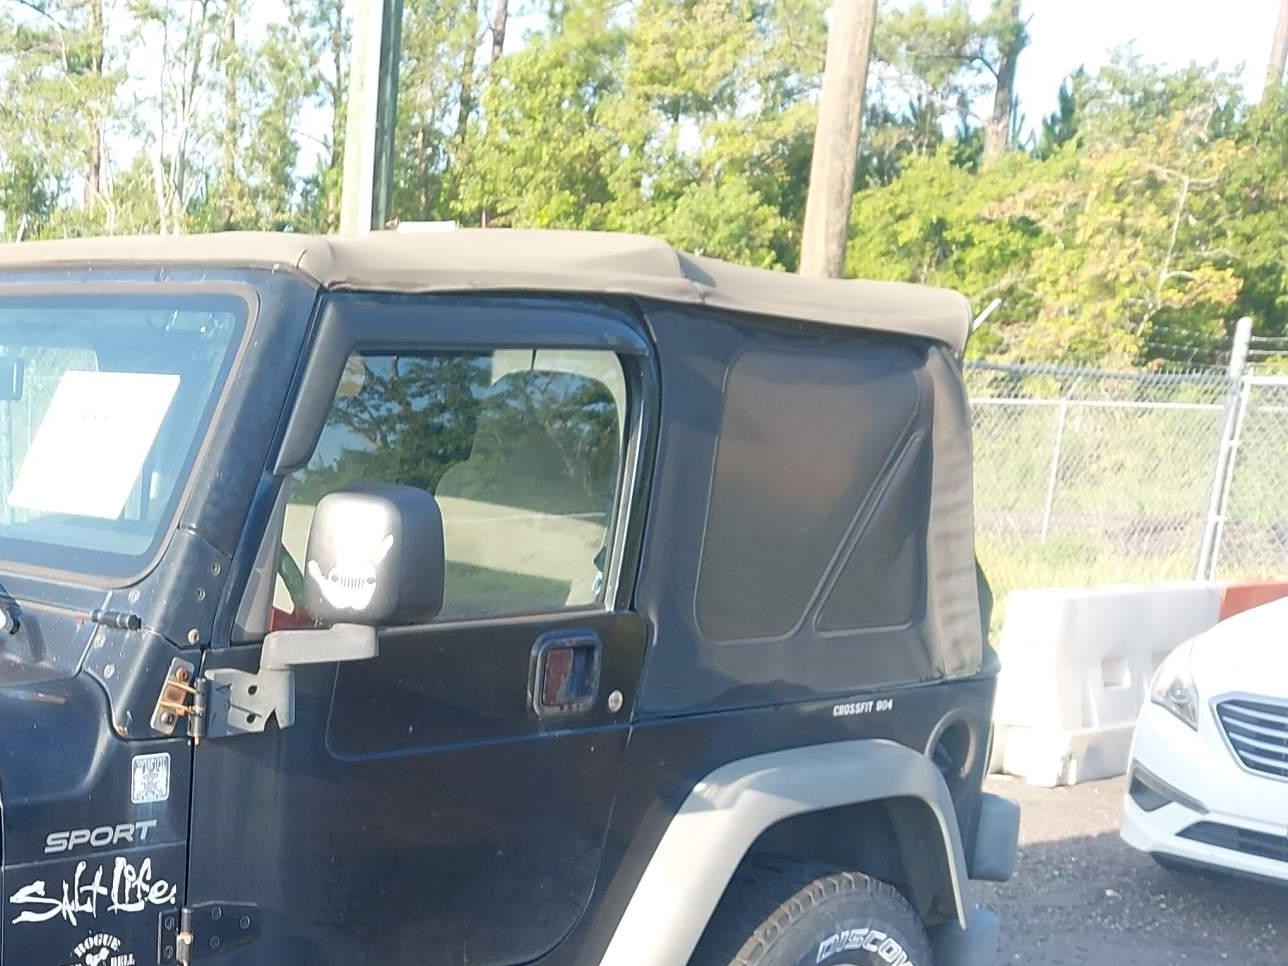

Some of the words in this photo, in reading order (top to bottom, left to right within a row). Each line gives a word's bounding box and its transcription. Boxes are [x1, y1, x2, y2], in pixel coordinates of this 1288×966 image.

[833, 701, 873, 717] CROSSFIT
[44, 819, 157, 853] SPORT
[73, 933, 121, 958] ROGUE
